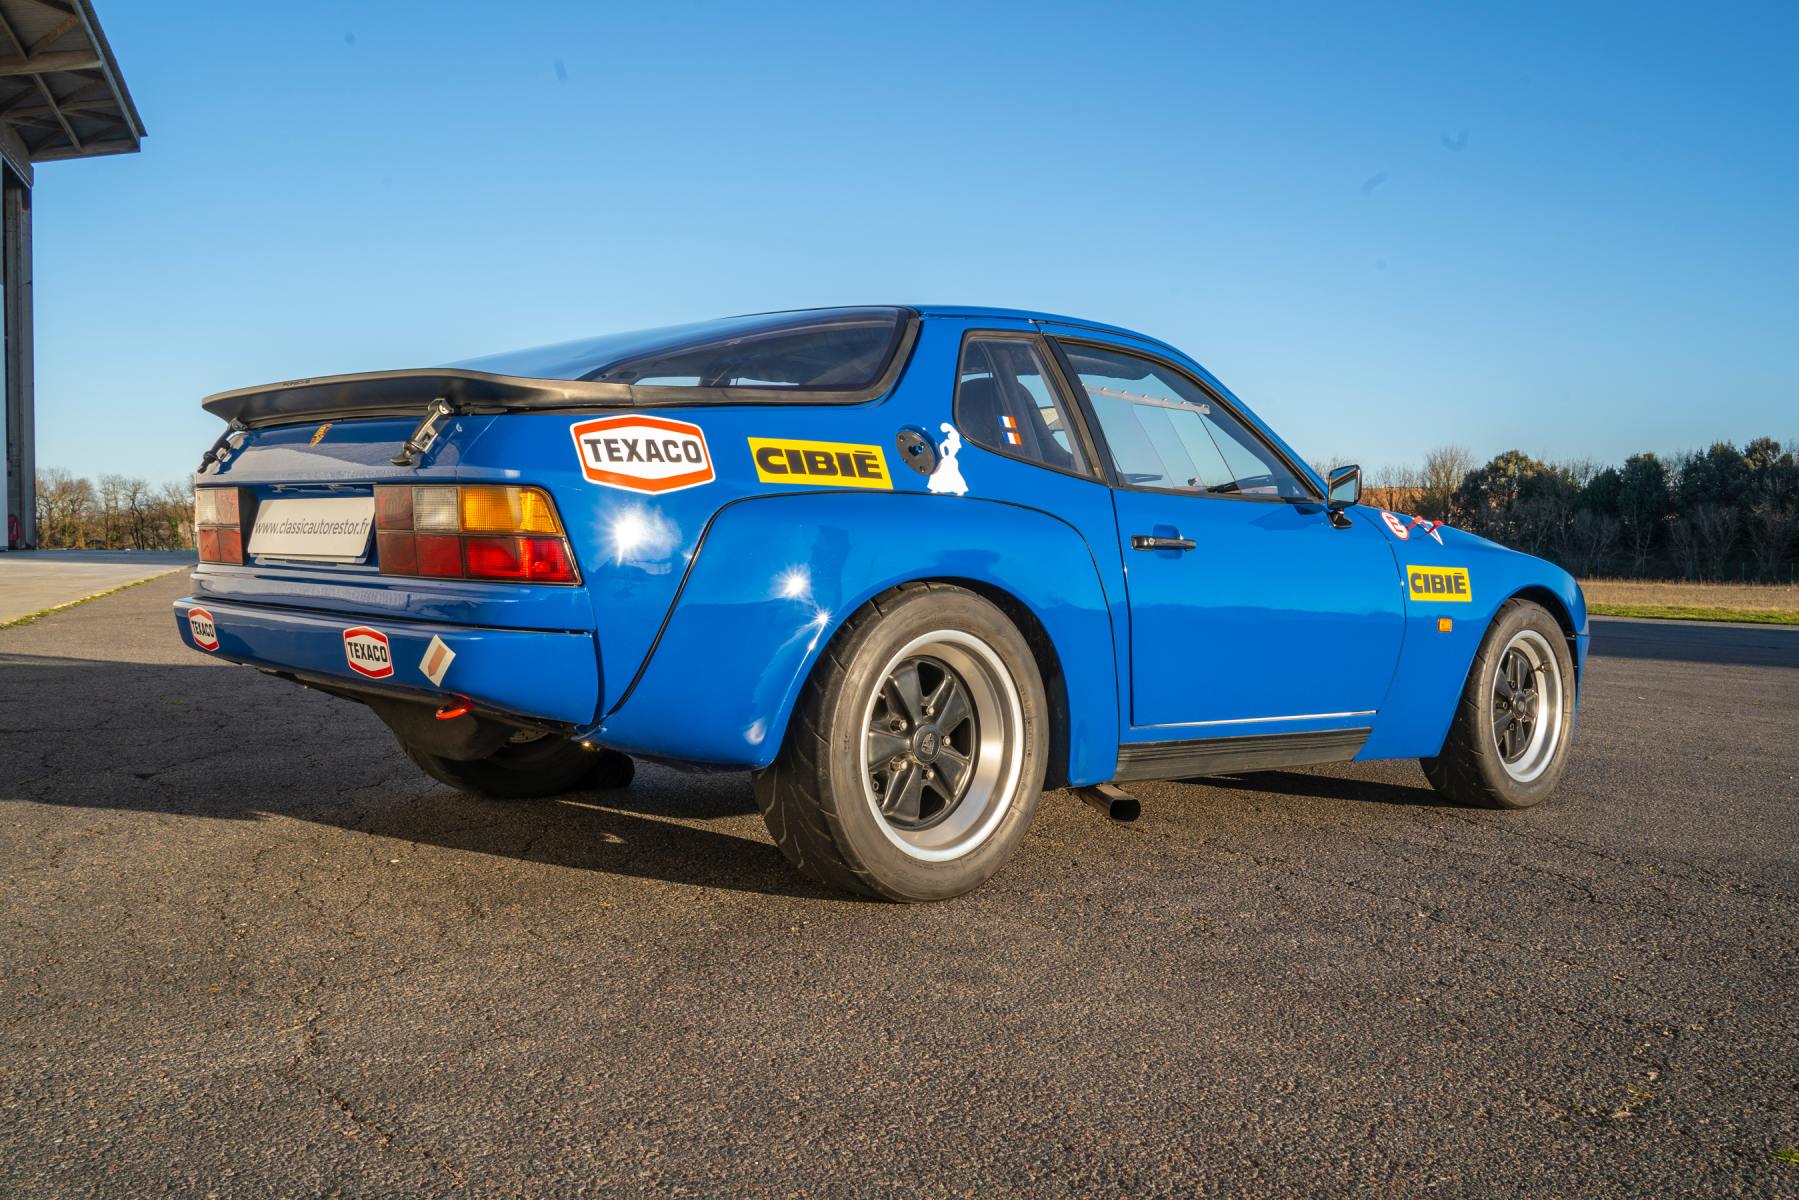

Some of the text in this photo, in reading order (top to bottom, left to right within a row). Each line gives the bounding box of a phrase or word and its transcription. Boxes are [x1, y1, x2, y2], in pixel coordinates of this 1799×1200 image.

[583, 438, 703, 464] TEXACO
[255, 518, 371, 535] www.classicautorestor.fr
[191, 620, 214, 638] TEXACO
[347, 641, 388, 662] TEXACO
